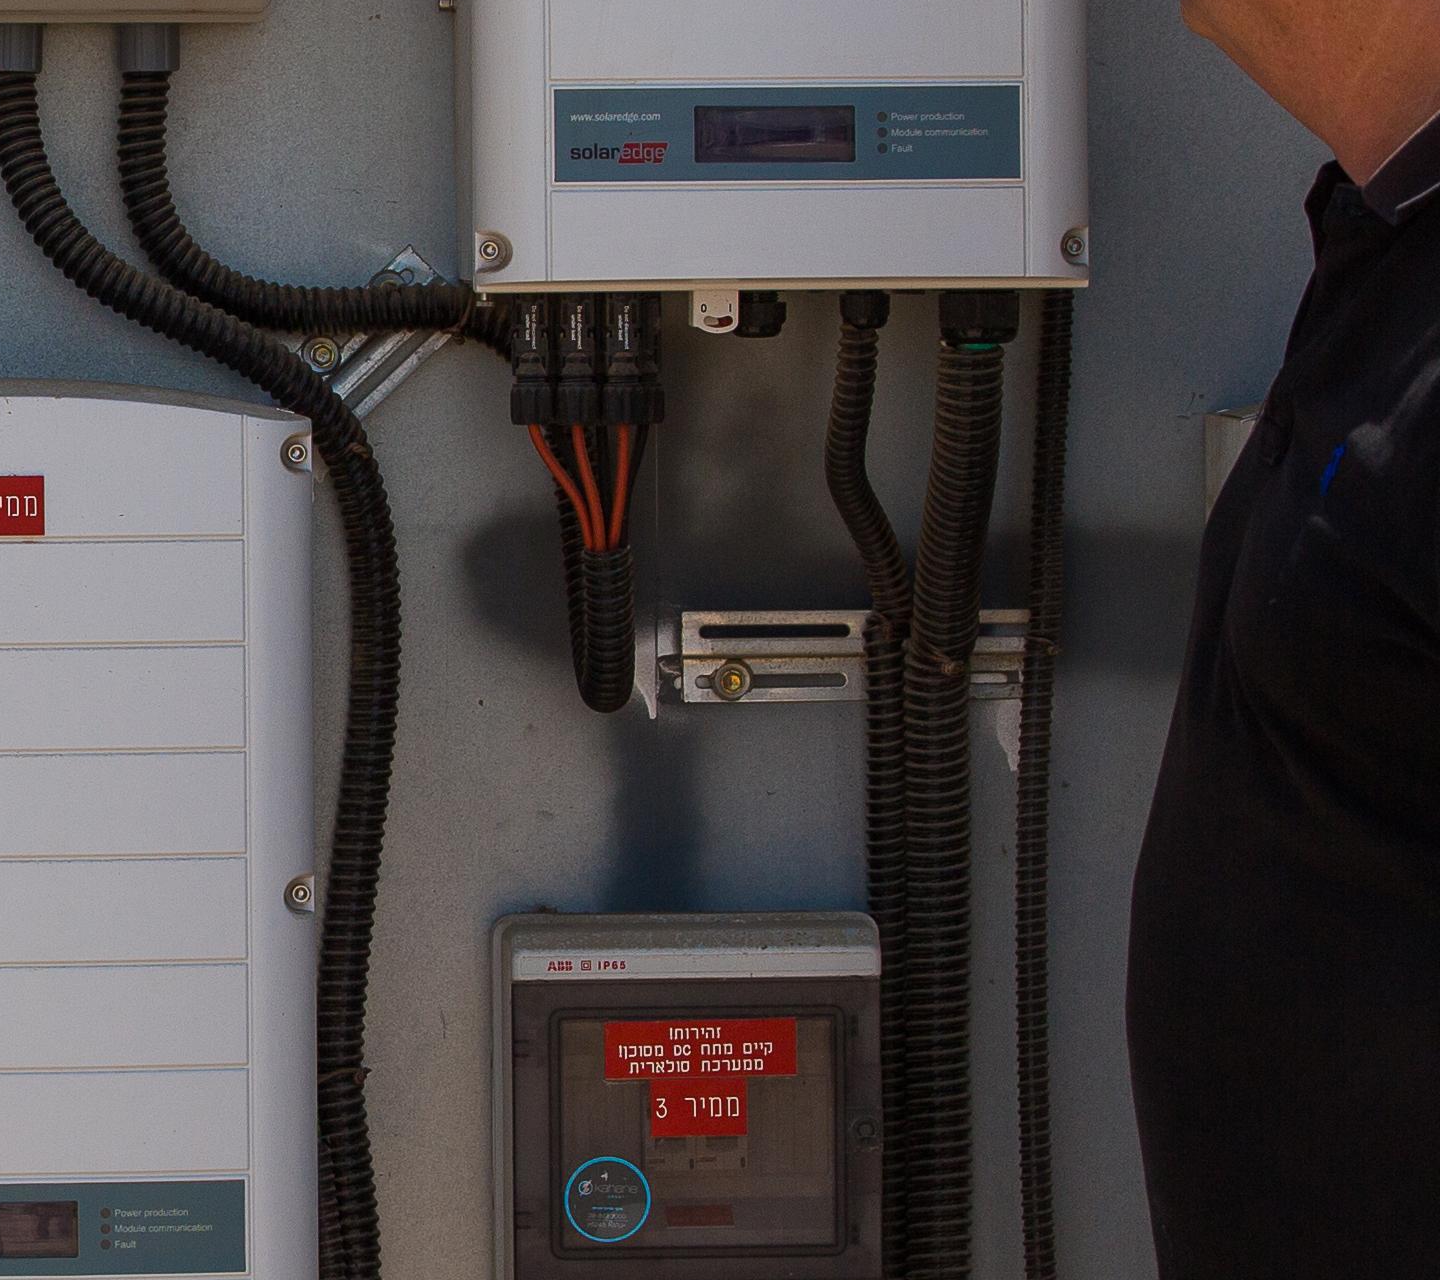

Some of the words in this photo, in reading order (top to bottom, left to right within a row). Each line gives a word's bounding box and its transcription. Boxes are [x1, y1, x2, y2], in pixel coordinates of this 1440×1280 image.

[570, 111, 661, 123] www.solaredge.com
[890, 112, 918, 121] Power
[920, 112, 965, 122] production
[891, 128, 923, 137] Module
[924, 127, 989, 137] communication
[891, 143, 913, 153] Fault
[547, 960, 573, 971] ABB
[598, 960, 626, 970] IP65
[669, 1027, 722, 1041] זהירות!
[618, 1044, 664, 1060] מסוכן!
[673, 1044, 691, 1057] DC
[700, 1043, 733, 1056] מתח
[742, 1041, 773, 1056] קיים
[629, 1059, 690, 1074] סולארית
[700, 1058, 764, 1072] ממערכת
[655, 1097, 668, 1119] 3
[684, 1096, 740, 1118] ממיר
[114, 1209, 142, 1217] Power
[143, 1208, 189, 1218] production
[114, 1224, 147, 1233] Module
[148, 1223, 213, 1232] communication
[114, 1240, 137, 1249] Fault
